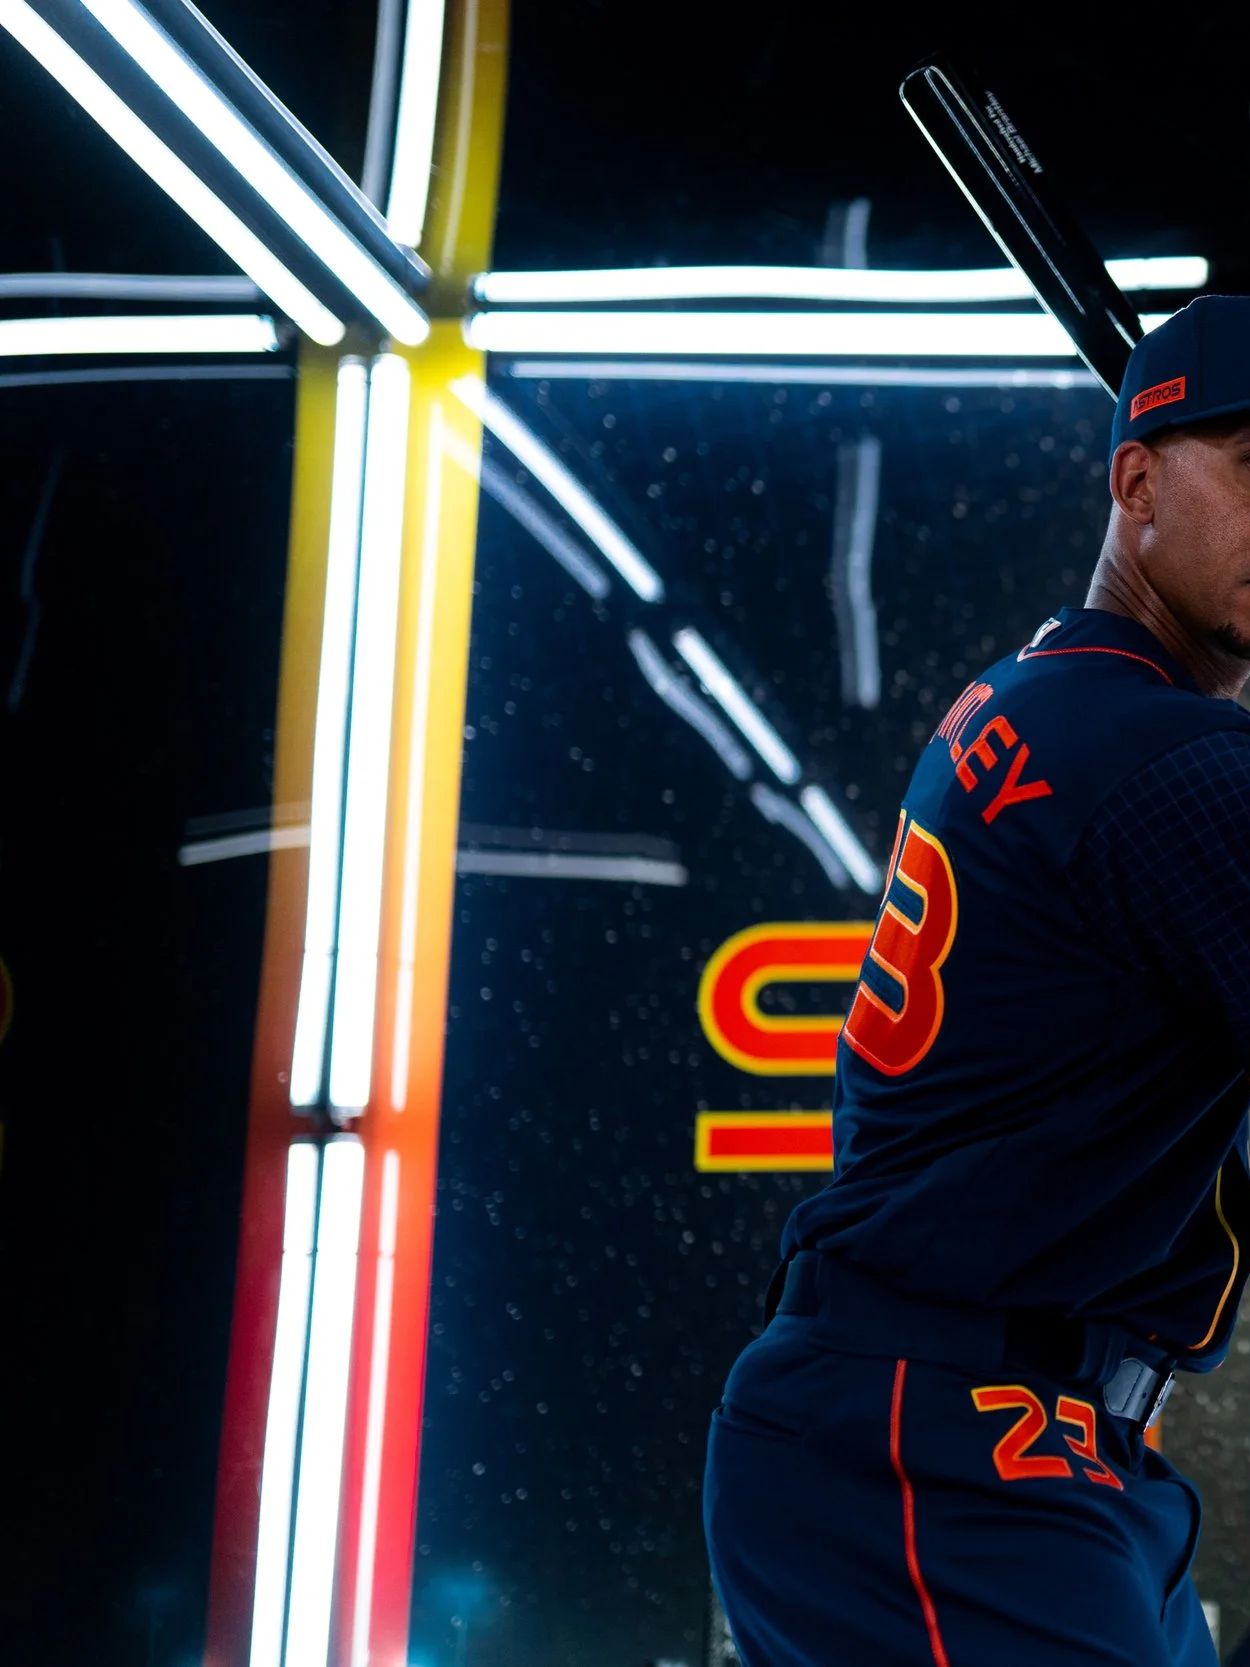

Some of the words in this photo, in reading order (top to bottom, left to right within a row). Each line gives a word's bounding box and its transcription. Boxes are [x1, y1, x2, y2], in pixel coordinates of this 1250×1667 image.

[985, 90, 1017, 133] Brantley
[1013, 134, 1043, 174] Michael
[843, 809, 958, 1077] 3
[970, 1384, 1125, 1492] 23
